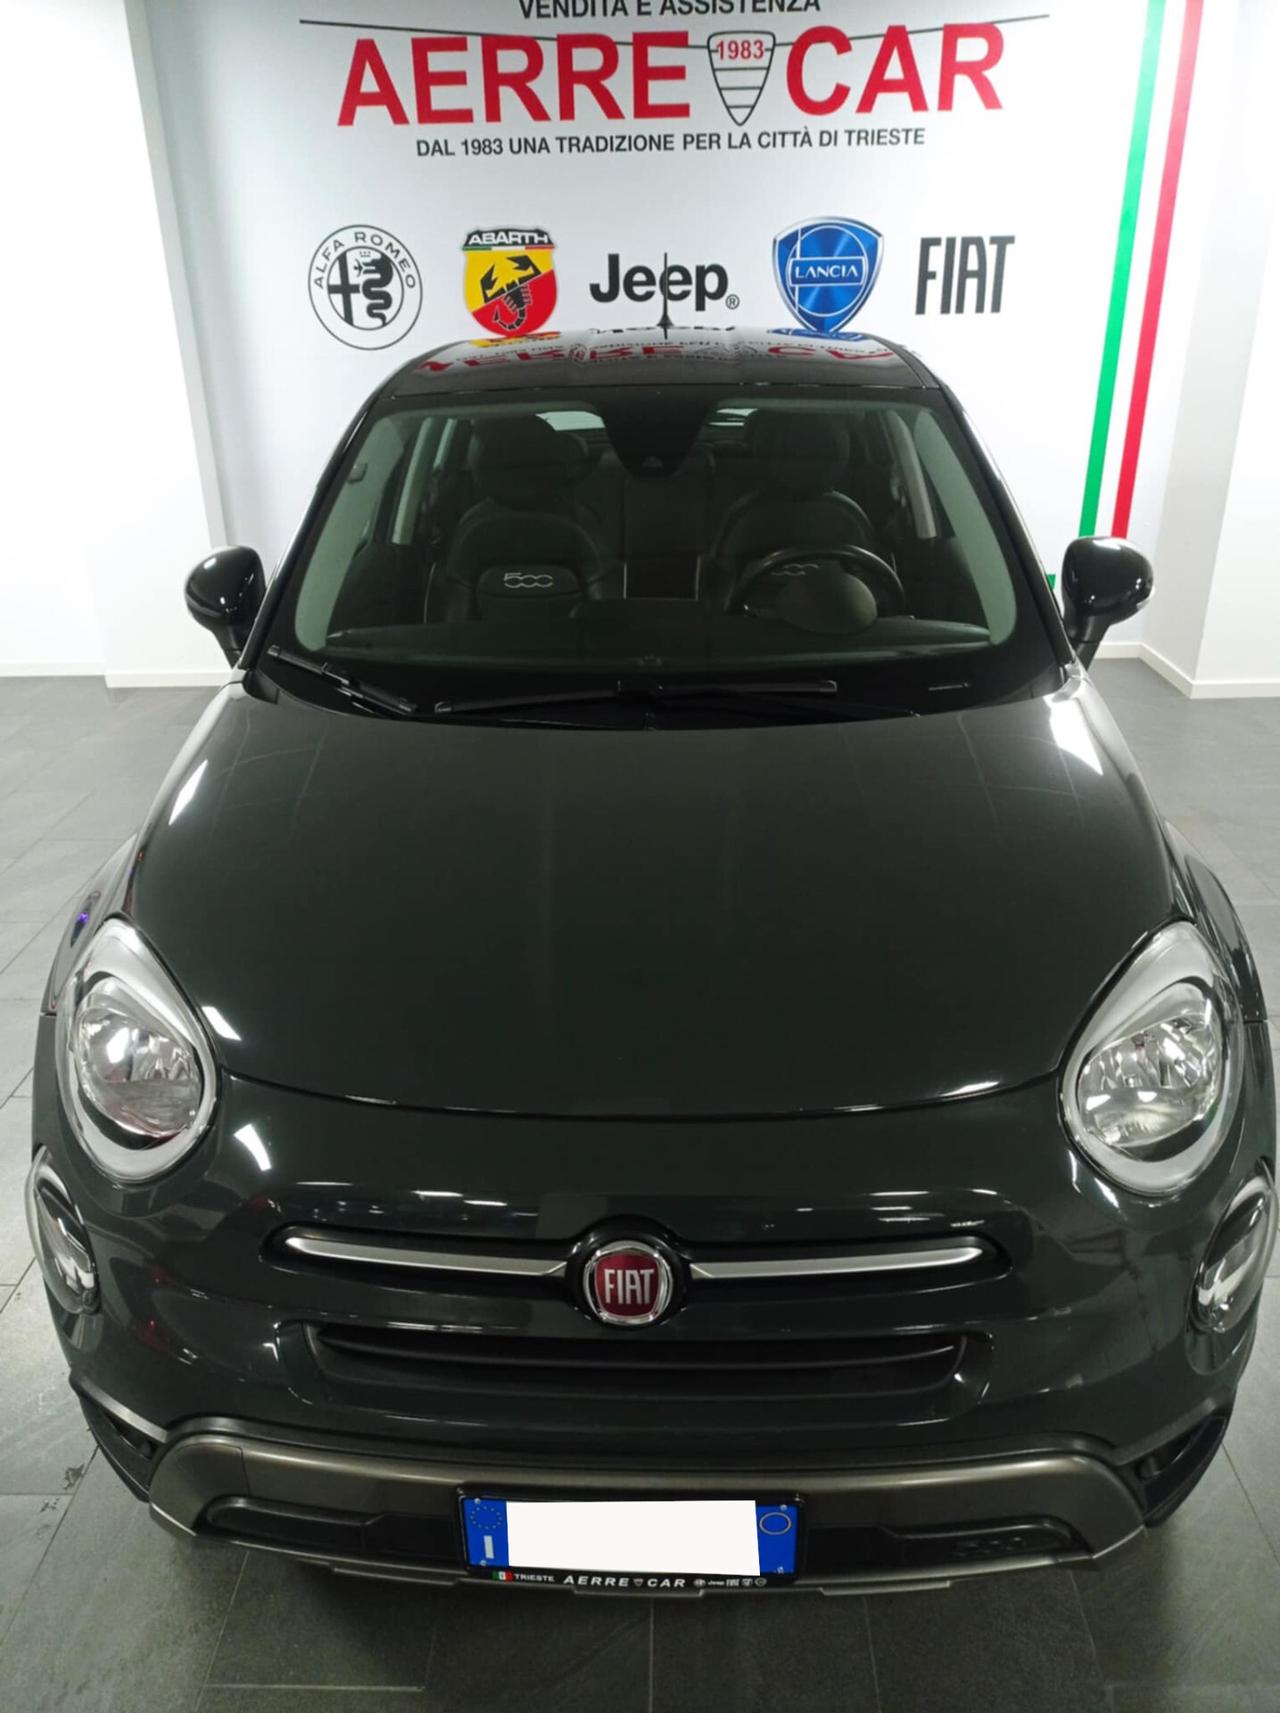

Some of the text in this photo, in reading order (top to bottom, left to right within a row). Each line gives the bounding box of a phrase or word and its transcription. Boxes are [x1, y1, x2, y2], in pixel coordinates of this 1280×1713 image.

[716, 39, 765, 60] 1983
[337, 23, 1004, 127] AERRE CAR
[416, 126, 925, 156] DAL 1983 UNA TRADIZIONE PER LA CITTÀ DI TRIESTE
[468, 232, 550, 246] ABARTH
[314, 231, 416, 290] ALFA ROMEO
[794, 264, 859, 279] LANCIA
[915, 235, 1016, 315] FIAT
[589, 253, 728, 312] Jeep
[503, 572, 554, 589] 500
[604, 1268, 654, 1304] FIAT
[514, 1573, 555, 1583] TRIESTE
[563, 1574, 630, 1587] AERRE
[647, 1578, 686, 1588] CAR
